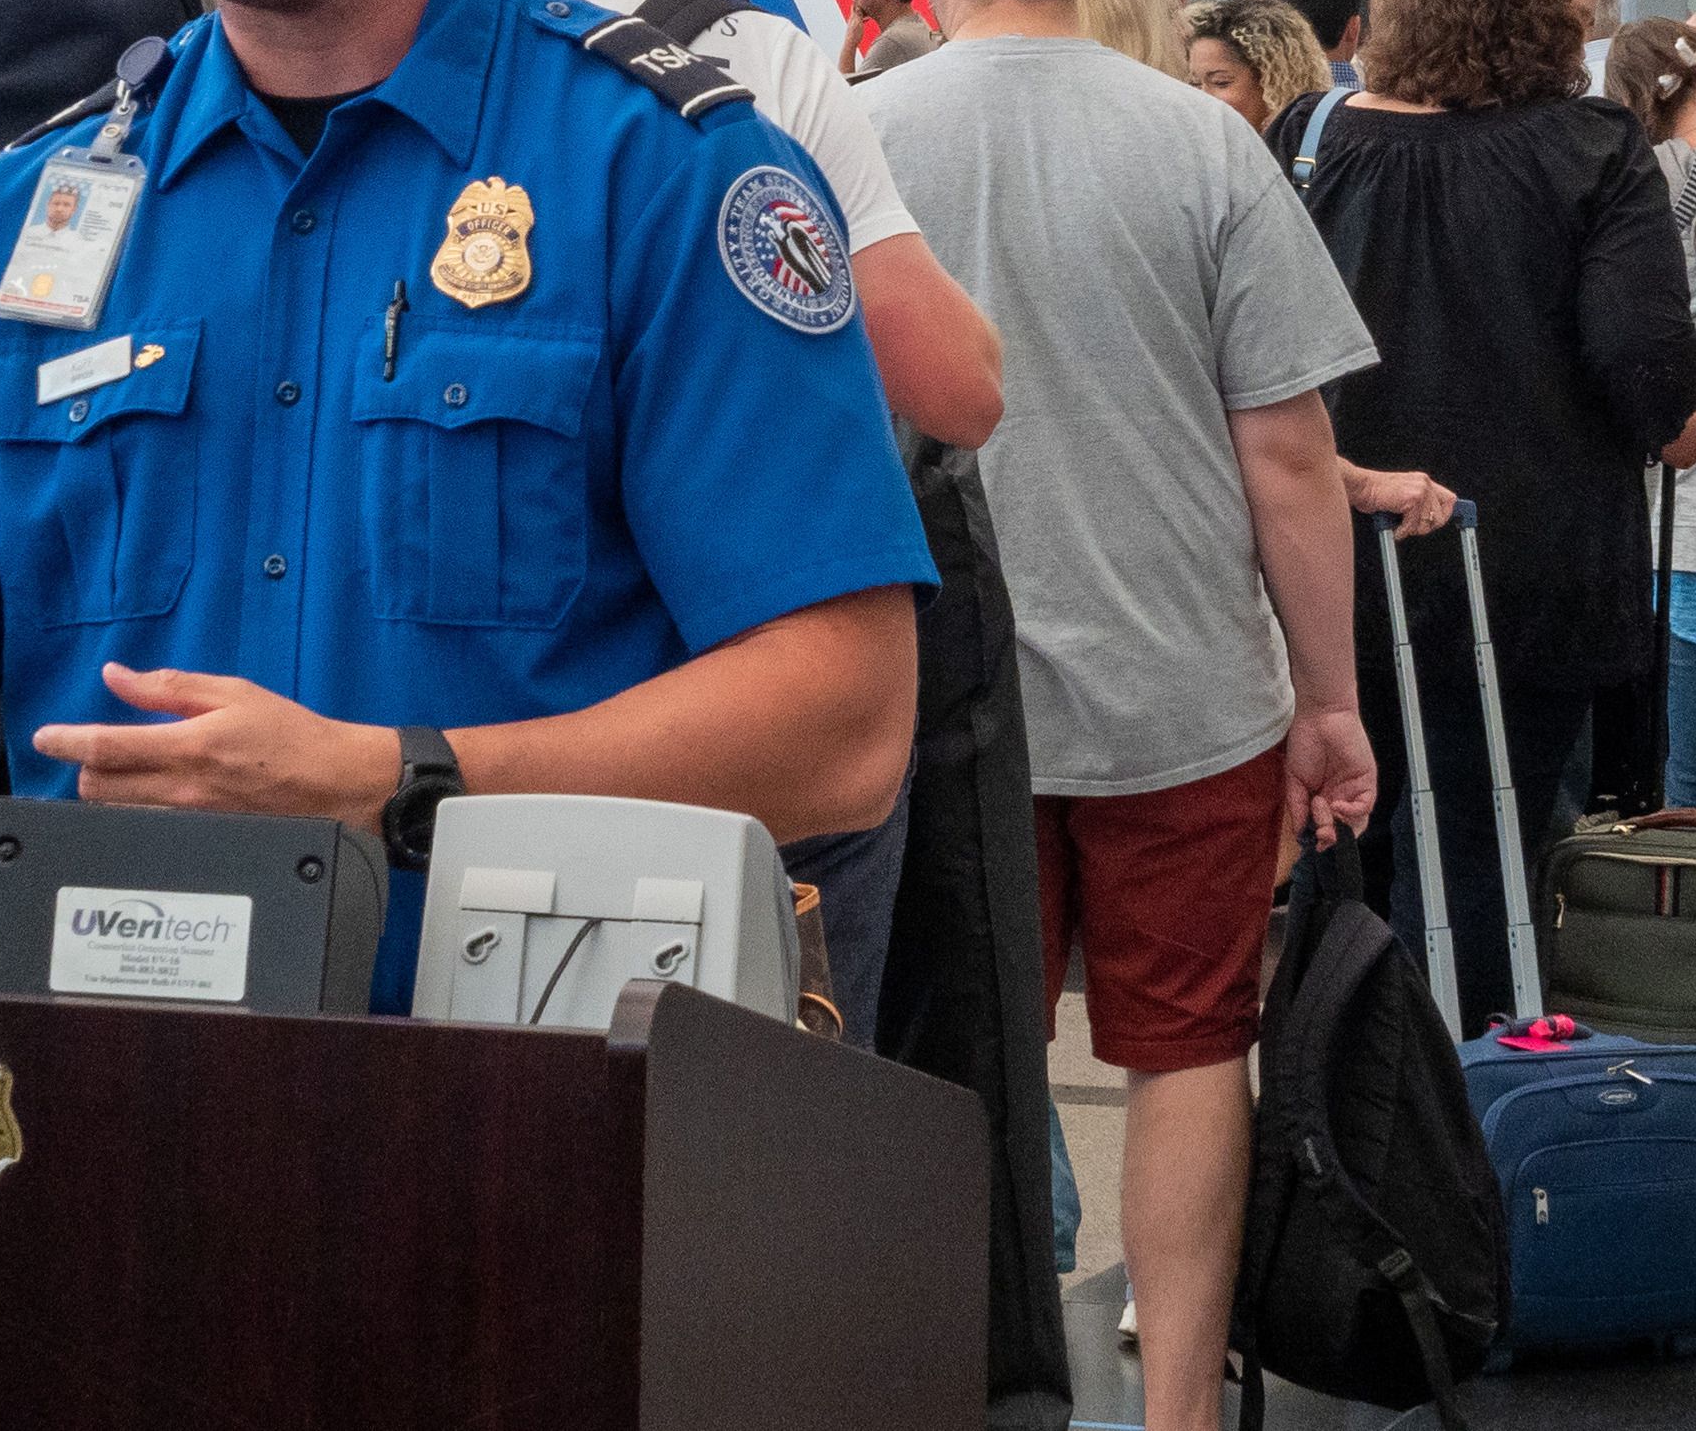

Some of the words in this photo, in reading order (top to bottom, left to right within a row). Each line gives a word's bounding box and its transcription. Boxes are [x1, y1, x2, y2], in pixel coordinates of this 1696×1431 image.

[629, 42, 703, 75] TSA
[466, 218, 512, 234] OFFICER
[71, 908, 231, 943] UVeritech
